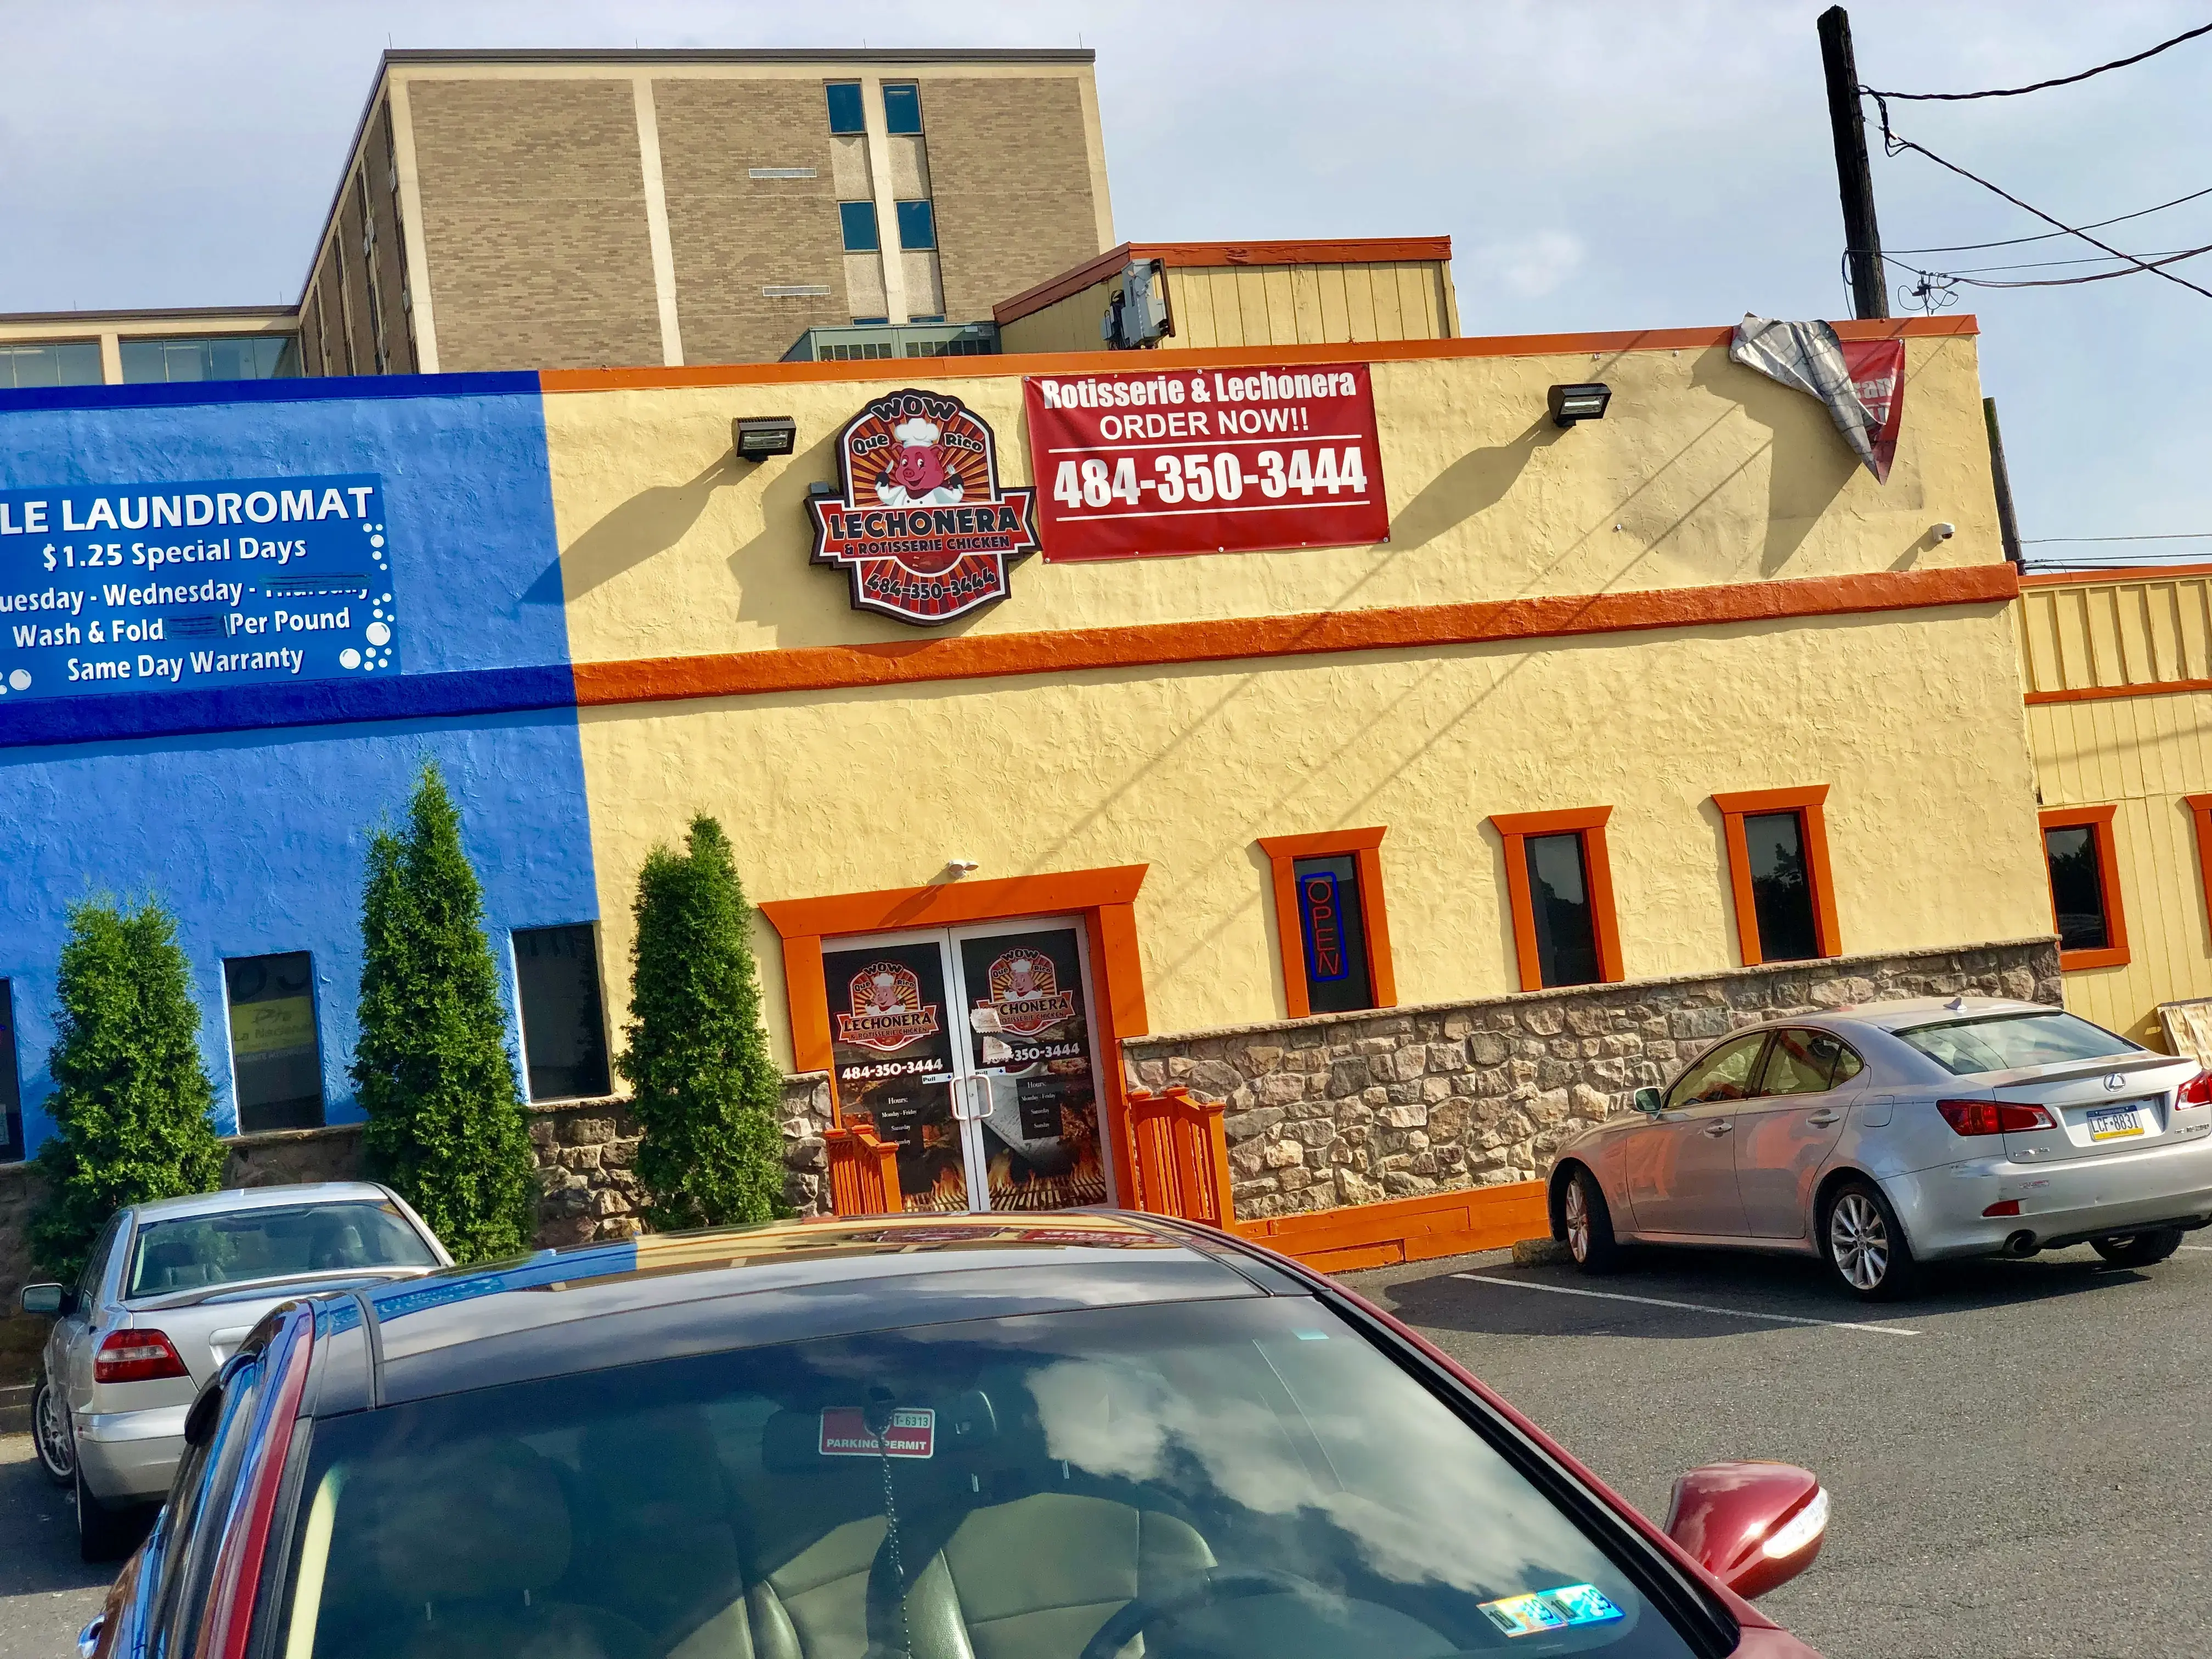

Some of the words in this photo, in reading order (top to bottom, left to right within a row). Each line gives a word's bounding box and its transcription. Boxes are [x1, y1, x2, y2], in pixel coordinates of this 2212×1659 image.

[1042, 375, 1184, 409] Rotisserie
[1191, 377, 1211, 403] &
[1215, 371, 1356, 402] Lechonera
[871, 394, 958, 421] WOW
[1100, 411, 1208, 441] ORDER
[1218, 407, 1310, 435] NOW!!
[851, 432, 889, 456] Que
[944, 433, 984, 453] Rico
[1053, 446, 1368, 509] 484-350-3444
[62, 487, 373, 531] LAUNDROMAT
[829, 507, 1022, 540] LECHONERA
[43, 543, 123, 572] $1.25
[132, 538, 230, 571] Special
[239, 537, 306, 565] Days
[844, 543, 855, 555] &
[858, 539, 943, 554] ROTISSERIE
[946, 535, 1011, 550] CHICKEN
[103, 579, 243, 607] Wednesday
[867, 567, 996, 600] 484-350-3444
[13, 622, 81, 647] Wash
[88, 620, 105, 643] &
[112, 618, 163, 642] Fold
[230, 613, 267, 634] Per
[275, 607, 349, 631] Pound
[67, 657, 130, 681] Same
[138, 655, 183, 683] Day
[190, 648, 304, 674] Warranty
[1307, 880, 1339, 975] OPEN
[1000, 949, 1039, 960] WOW
[863, 962, 903, 975] WOW
[992, 967, 1009, 978] Que
[1034, 965, 1052, 973] Rico
[854, 981, 871, 992] Que
[896, 979, 915, 988] Rico
[985, 998, 1068, 1017] CHONERA
[1000, 1015, 1034, 1024] OTISSERIE
[1036, 1011, 1064, 1019] CHICKEN
[844, 1013, 932, 1032] LECHONERA
[858, 1030, 896, 1039] ROTISSERIE
[842, 1058, 943, 1080] 484-350-3444
[894, 1415, 929, 1426] T-6313
[827, 1439, 878, 1448] PARKING
